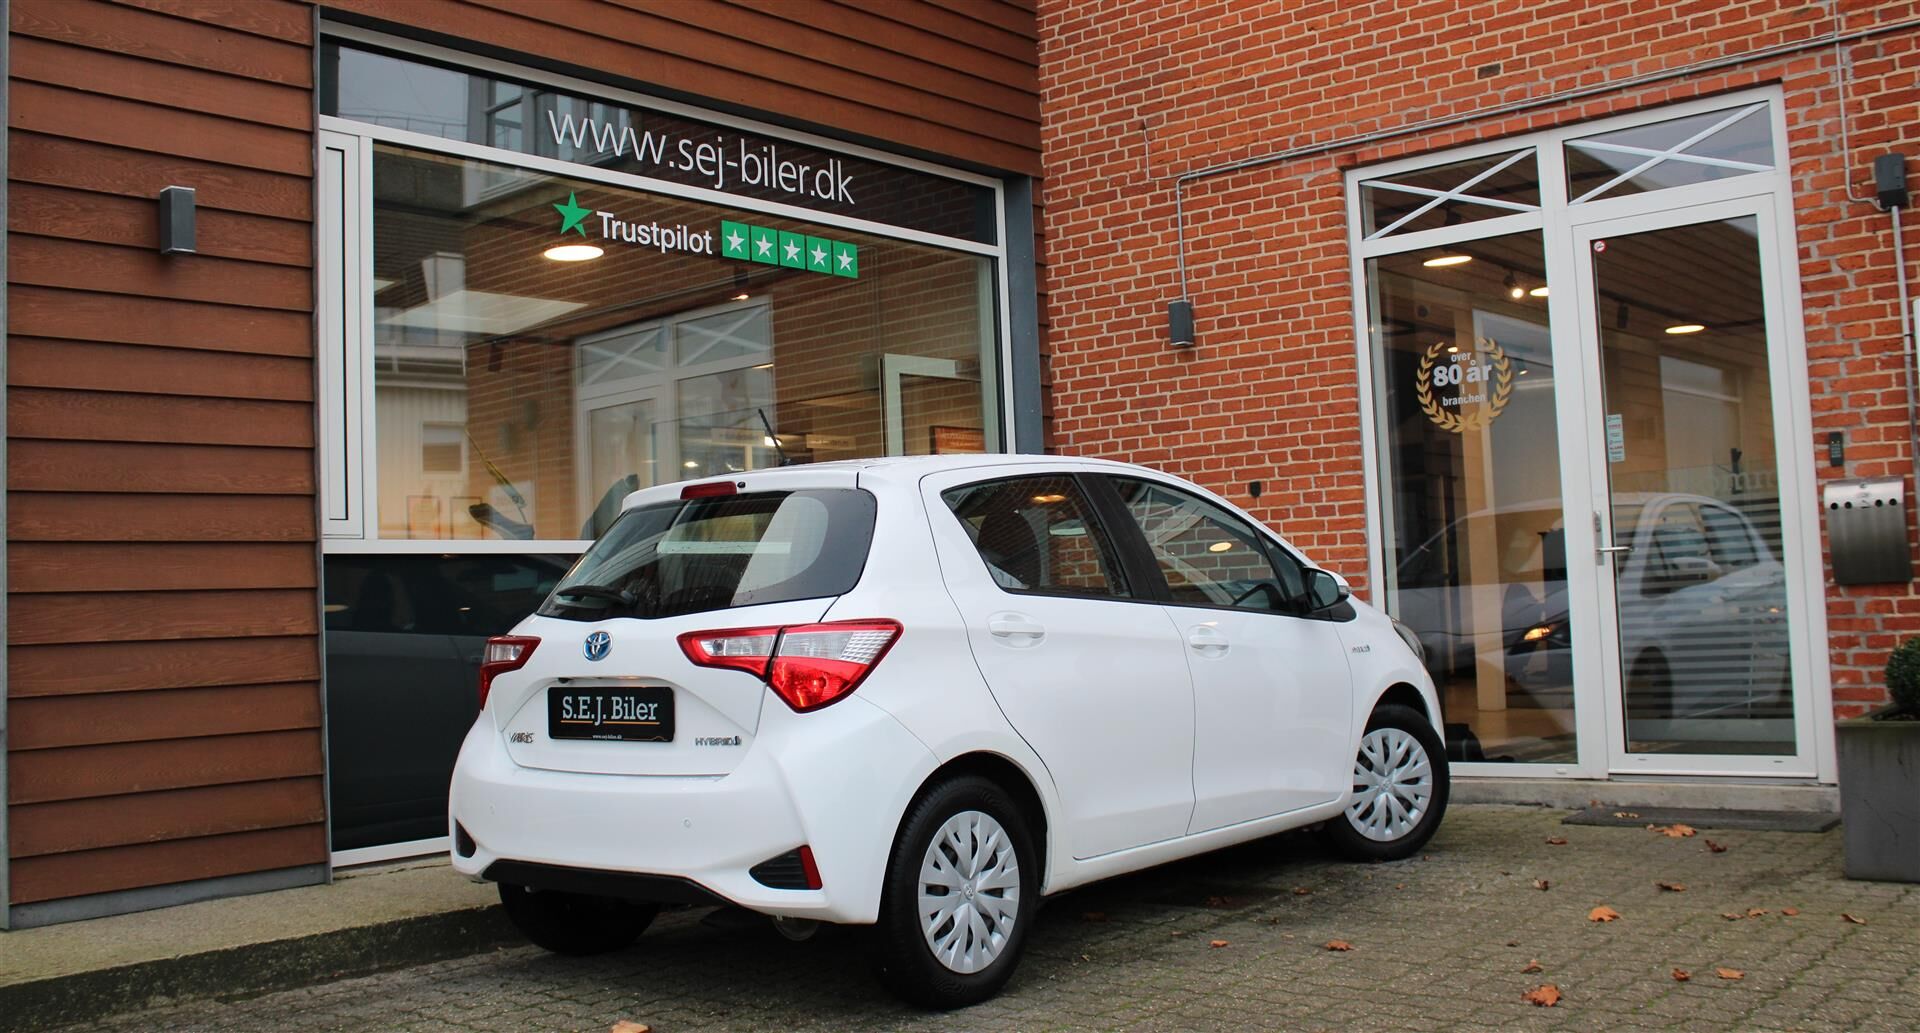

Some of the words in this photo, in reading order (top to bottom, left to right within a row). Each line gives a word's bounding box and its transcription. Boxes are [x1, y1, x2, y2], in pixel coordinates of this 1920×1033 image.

[548, 110, 855, 204] www.sej-biler.dk
[596, 211, 713, 255] Trustpilot
[1451, 352, 1472, 362] over
[1433, 364, 1463, 387] 80
[1466, 359, 1492, 383] år
[1442, 394, 1486, 407] branchen
[562, 696, 607, 726] S.E.J.
[611, 696, 658, 721] Biler
